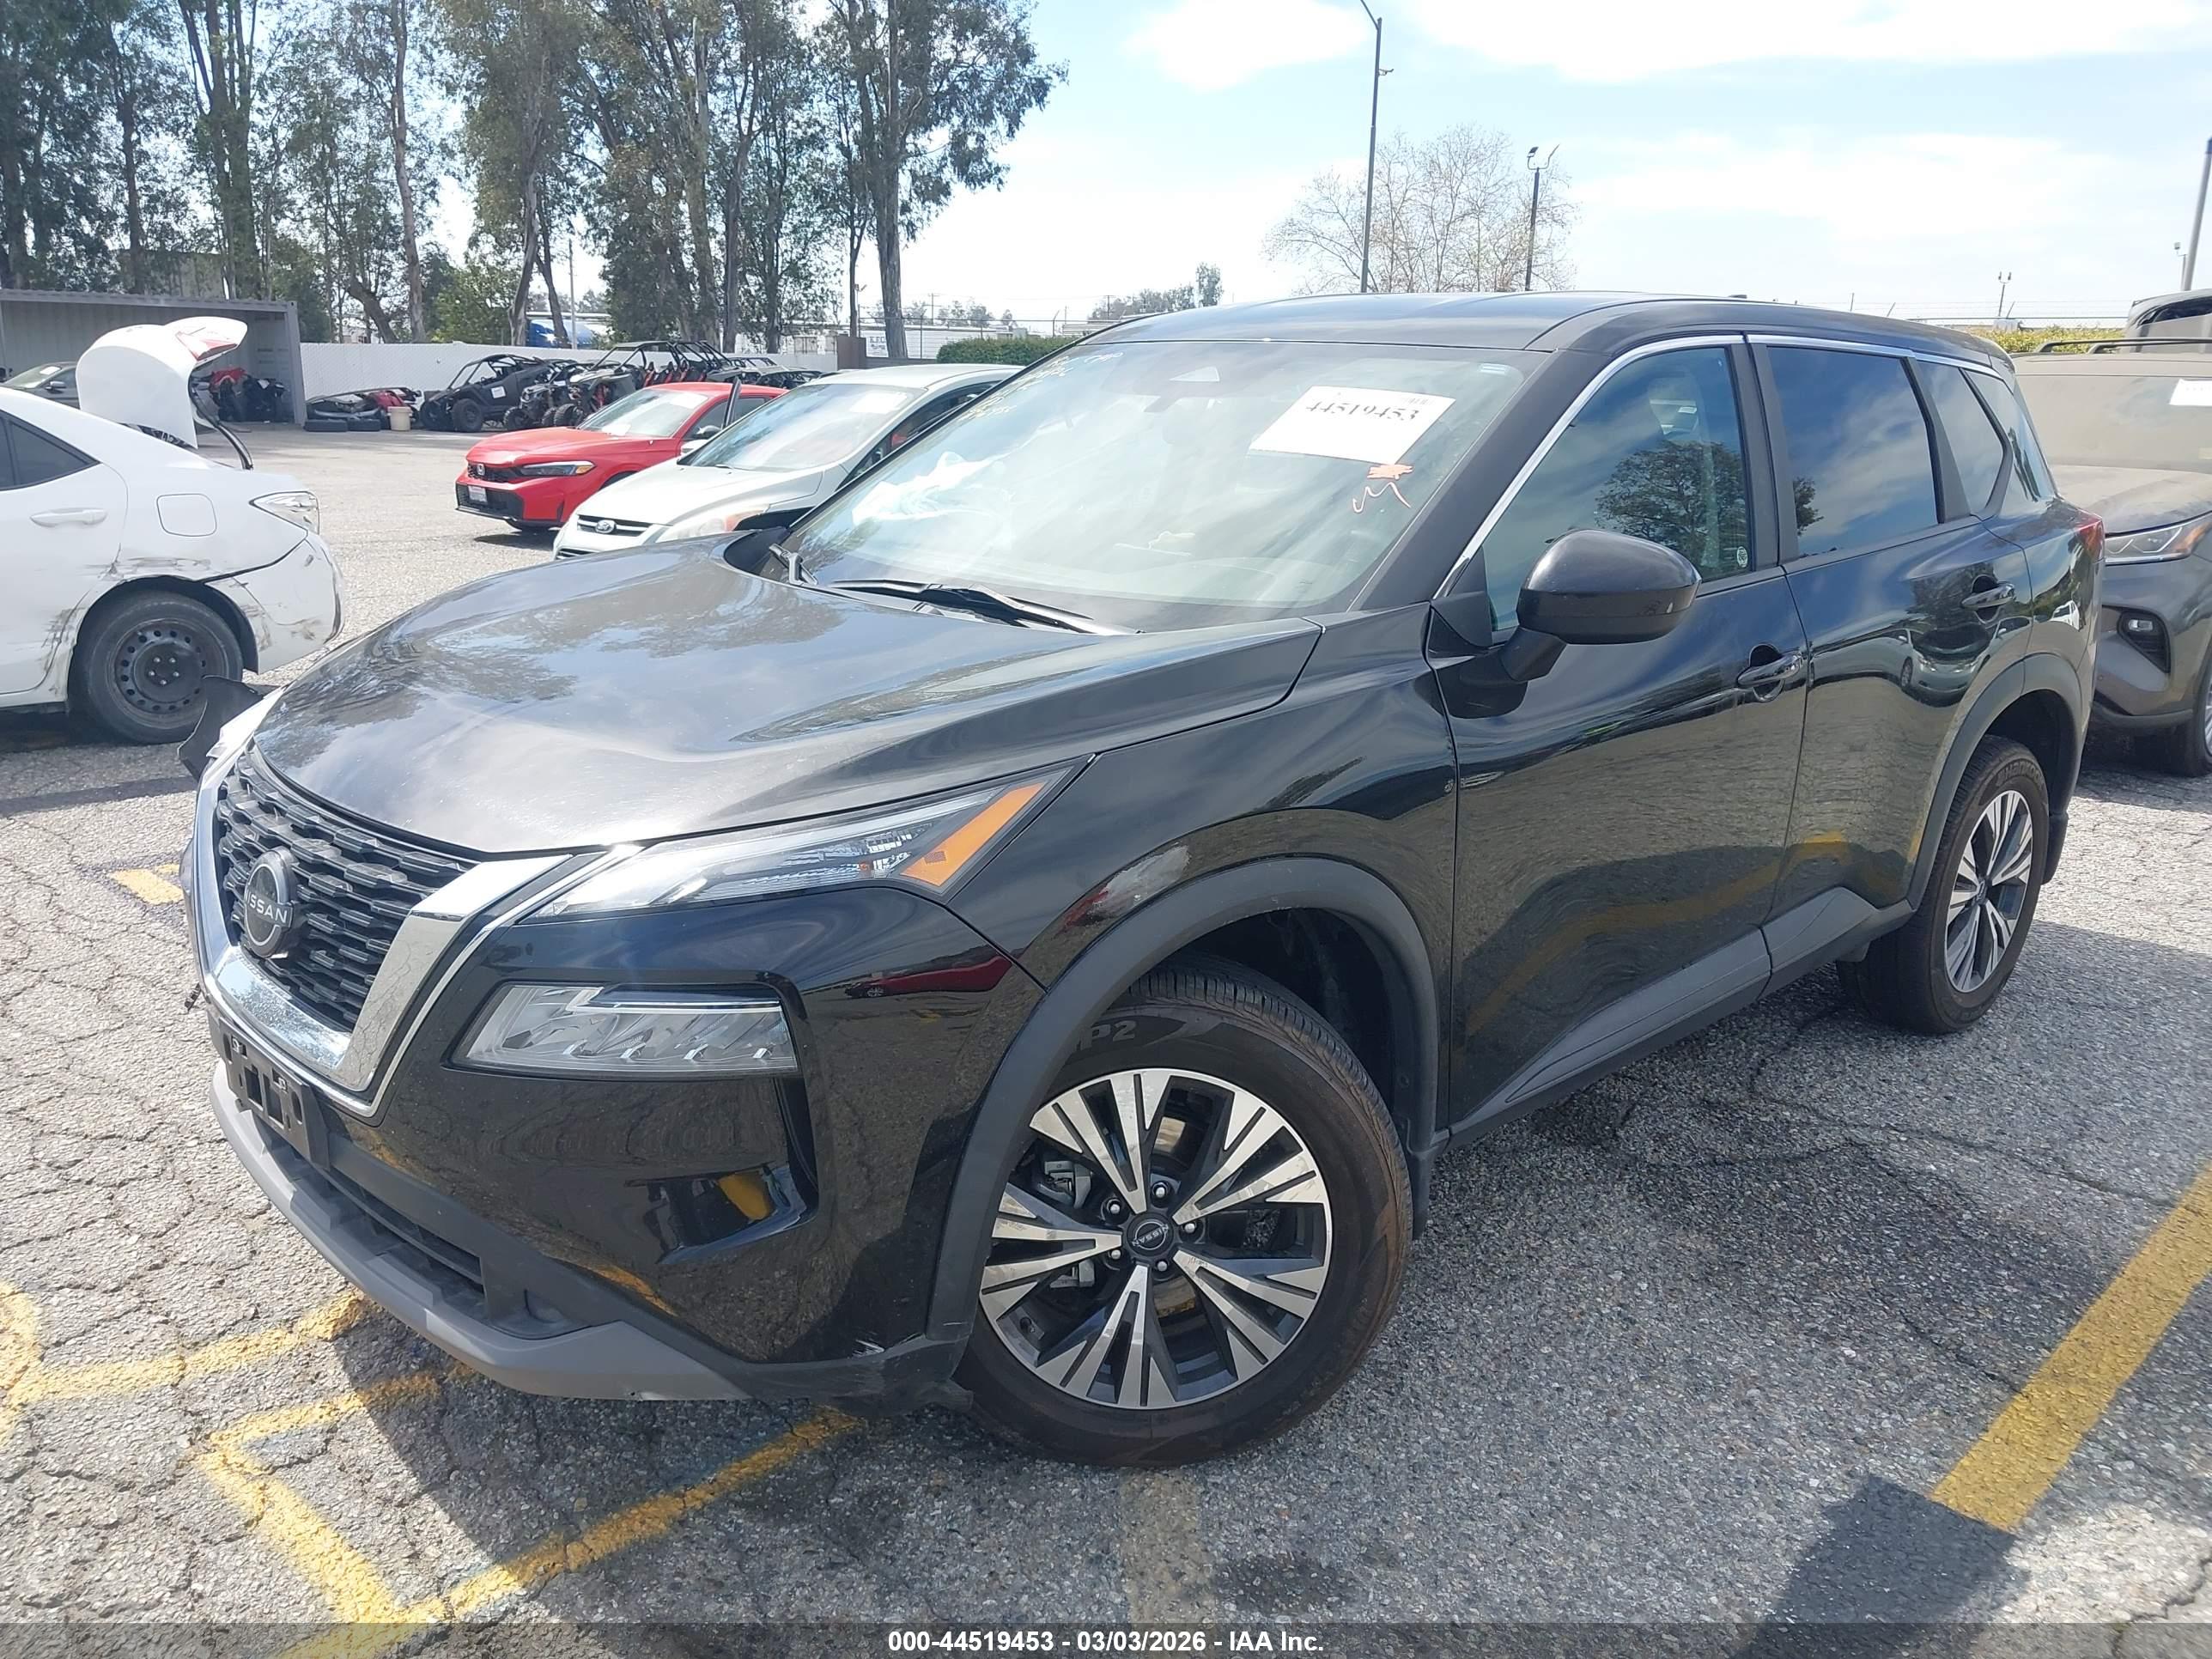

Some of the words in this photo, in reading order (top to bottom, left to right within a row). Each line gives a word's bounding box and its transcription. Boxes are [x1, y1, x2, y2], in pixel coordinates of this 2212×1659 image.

[1304, 399, 1420, 422] 44519453
[244, 890, 288, 924] NISSAN
[1131, 1224, 1170, 1247] NISSAN
